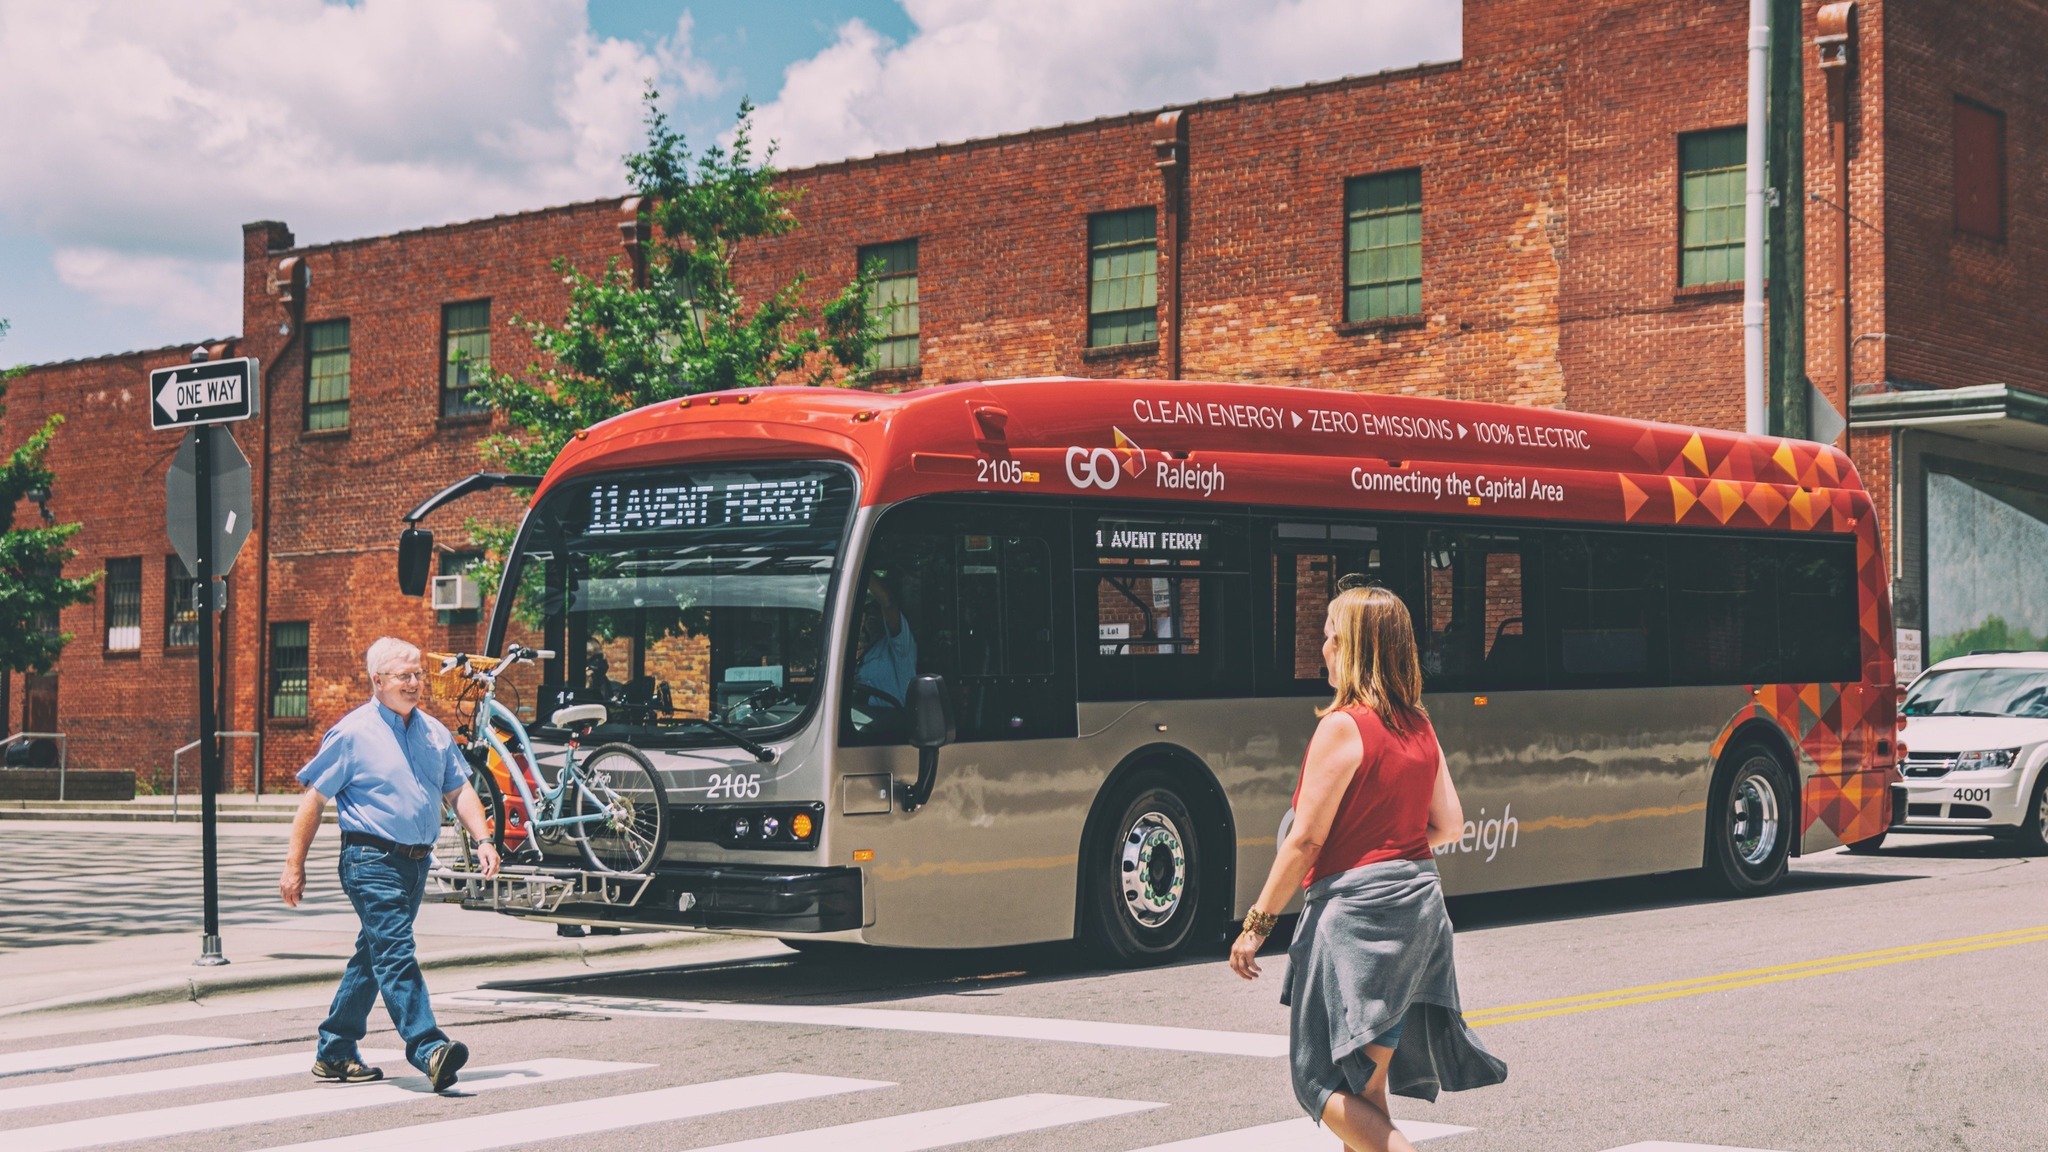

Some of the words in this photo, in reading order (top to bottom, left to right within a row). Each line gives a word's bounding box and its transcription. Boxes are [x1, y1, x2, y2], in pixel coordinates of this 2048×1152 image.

[177, 384, 202, 406] ONE
[207, 379, 237, 402] WAY
[1133, 399, 1204, 425] CLEAN
[1207, 403, 1284, 429] ENERGY
[1308, 409, 1359, 434] ZERO
[1361, 413, 1454, 441] EMISSIONS
[1473, 421, 1515, 445] 100%
[1516, 426, 1591, 450] ELECTRIC
[977, 459, 1022, 484] 2105
[1065, 446, 1120, 490] GO
[1156, 461, 1225, 497] Raleigh
[1351, 467, 1442, 500] Connecting
[1446, 472, 1471, 496] the
[1475, 475, 1527, 503] Capital
[1530, 479, 1564, 502] Area
[725, 480, 818, 522] FERRY
[1096, 530, 1104, 548] 1
[1111, 530, 1156, 549] AVENT
[1161, 532, 1202, 551] FERRY
[706, 774, 761, 799] 2105
[1953, 788, 1991, 801] 4001
